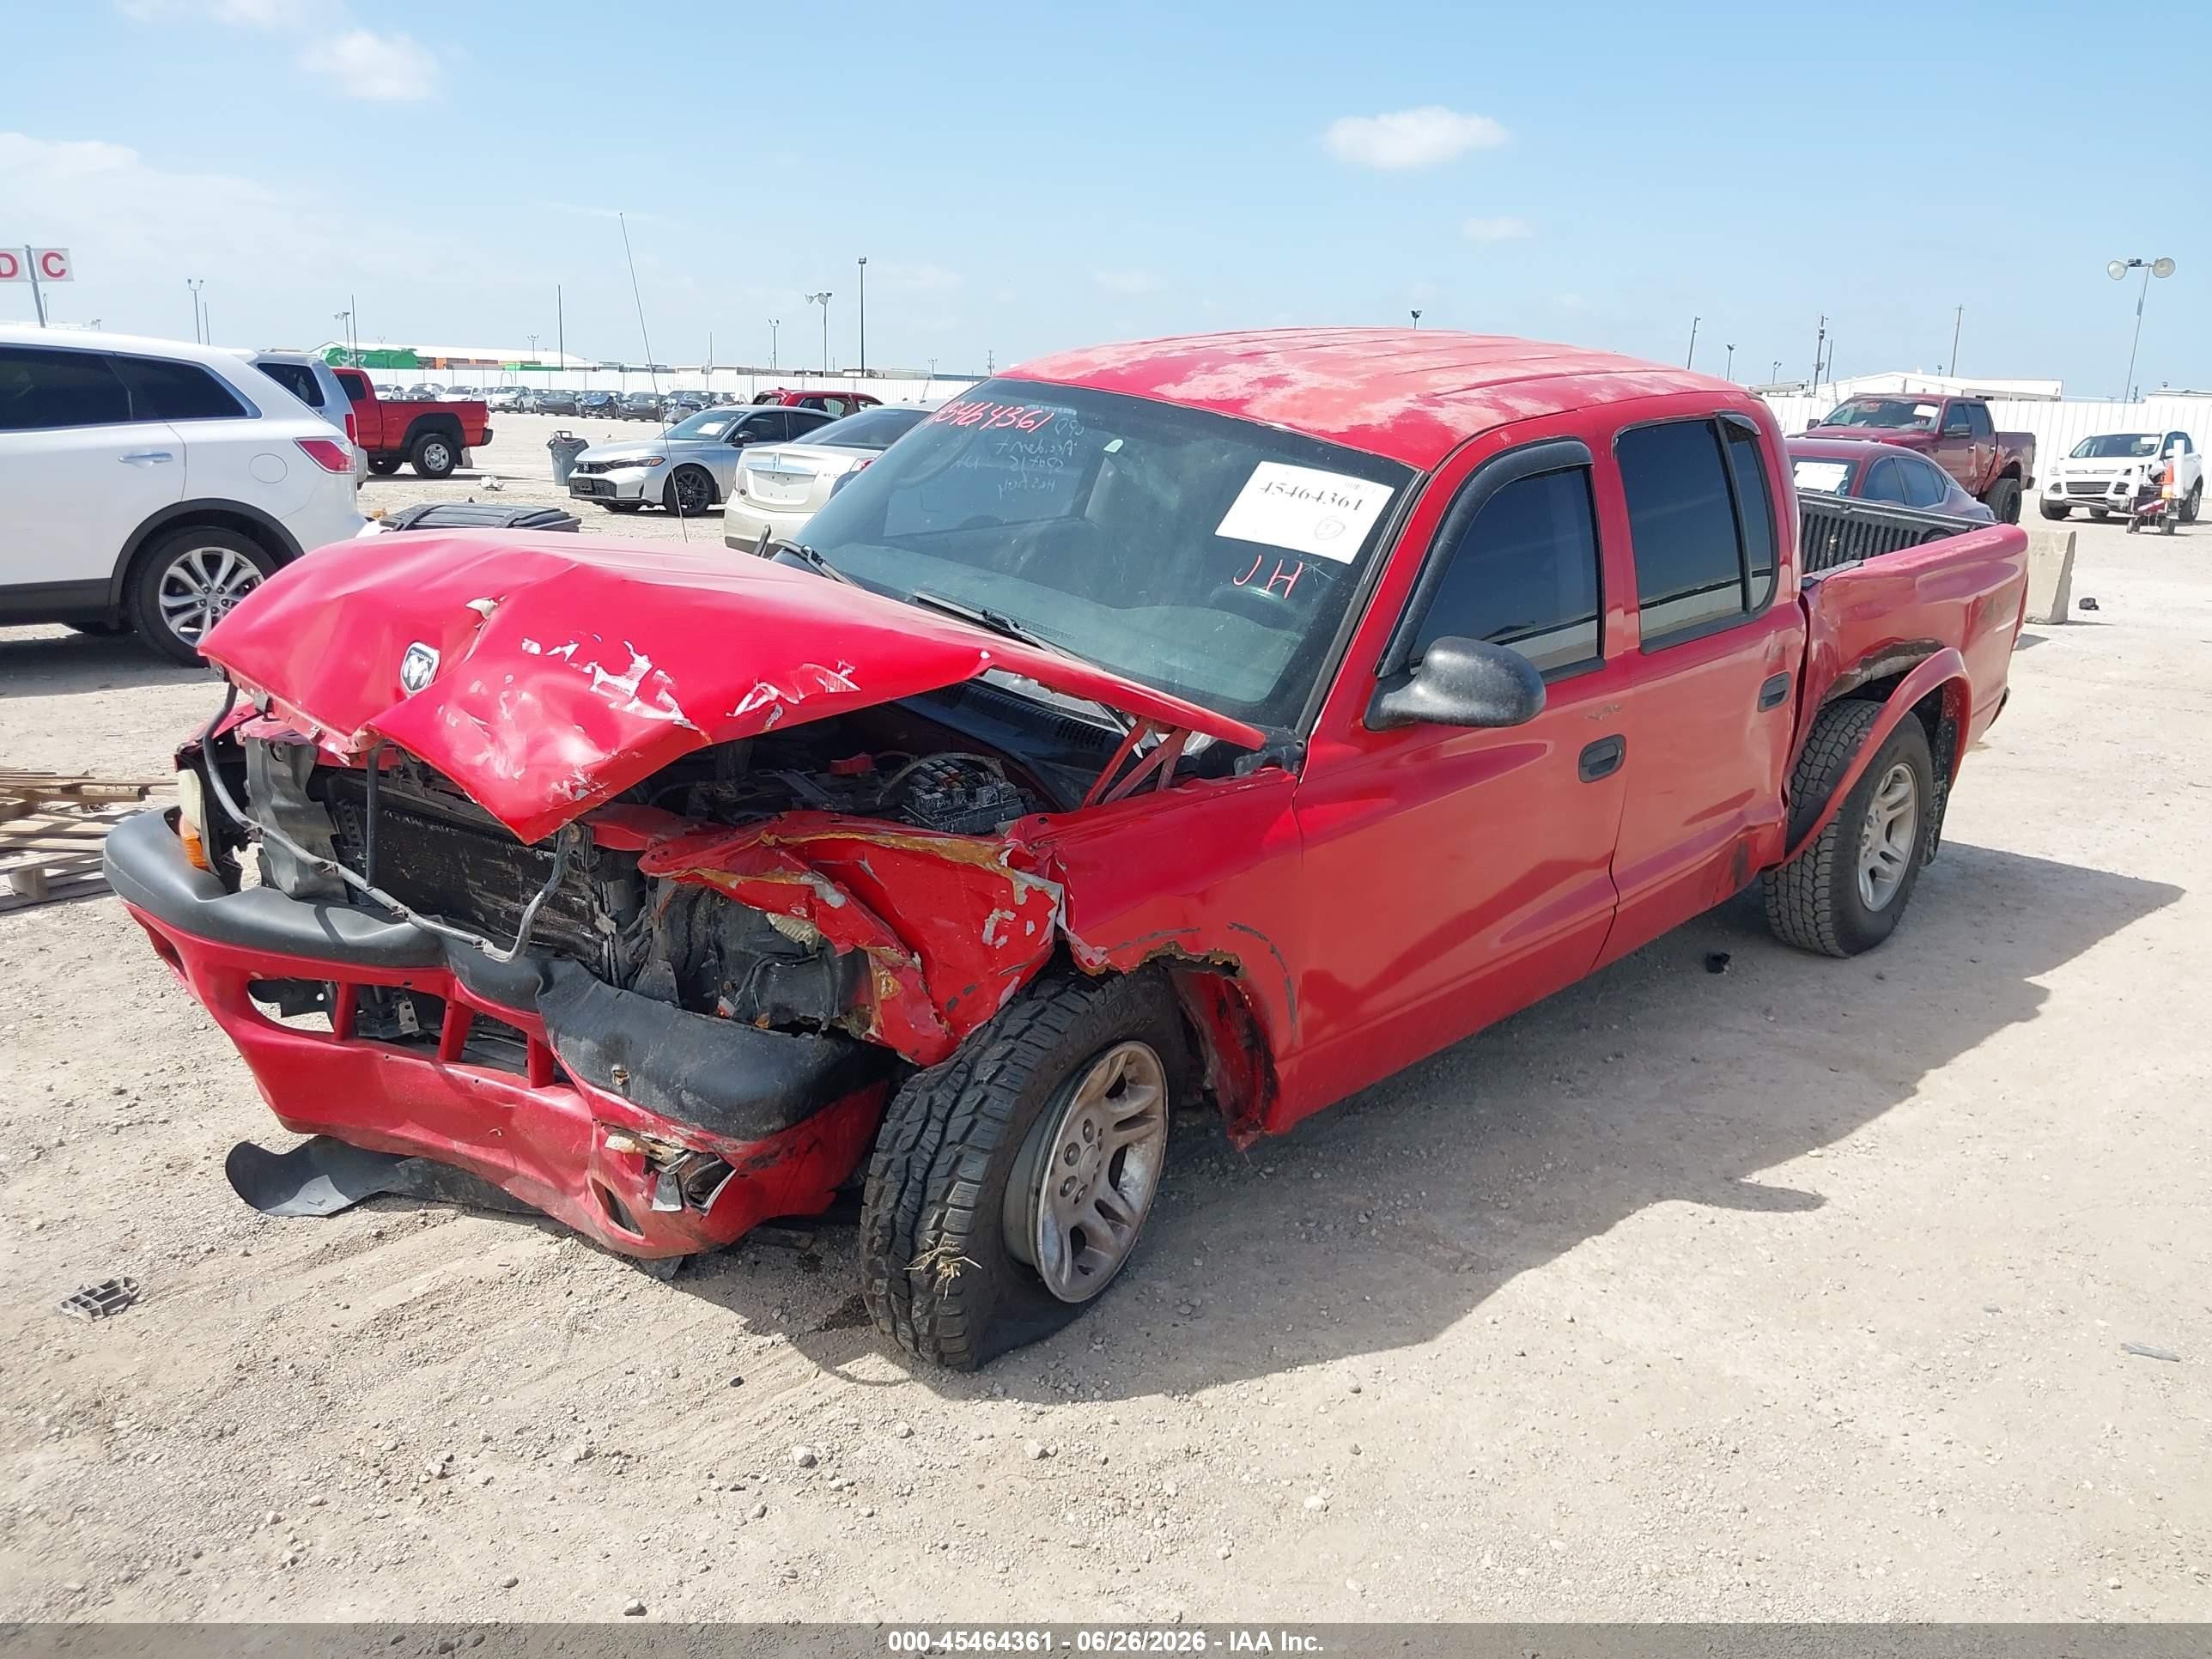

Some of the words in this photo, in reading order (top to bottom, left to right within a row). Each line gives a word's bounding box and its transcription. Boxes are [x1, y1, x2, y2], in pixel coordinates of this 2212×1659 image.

[0, 252, 19, 278] D
[41, 252, 67, 279] C
[1260, 480, 1364, 512] 45464361
